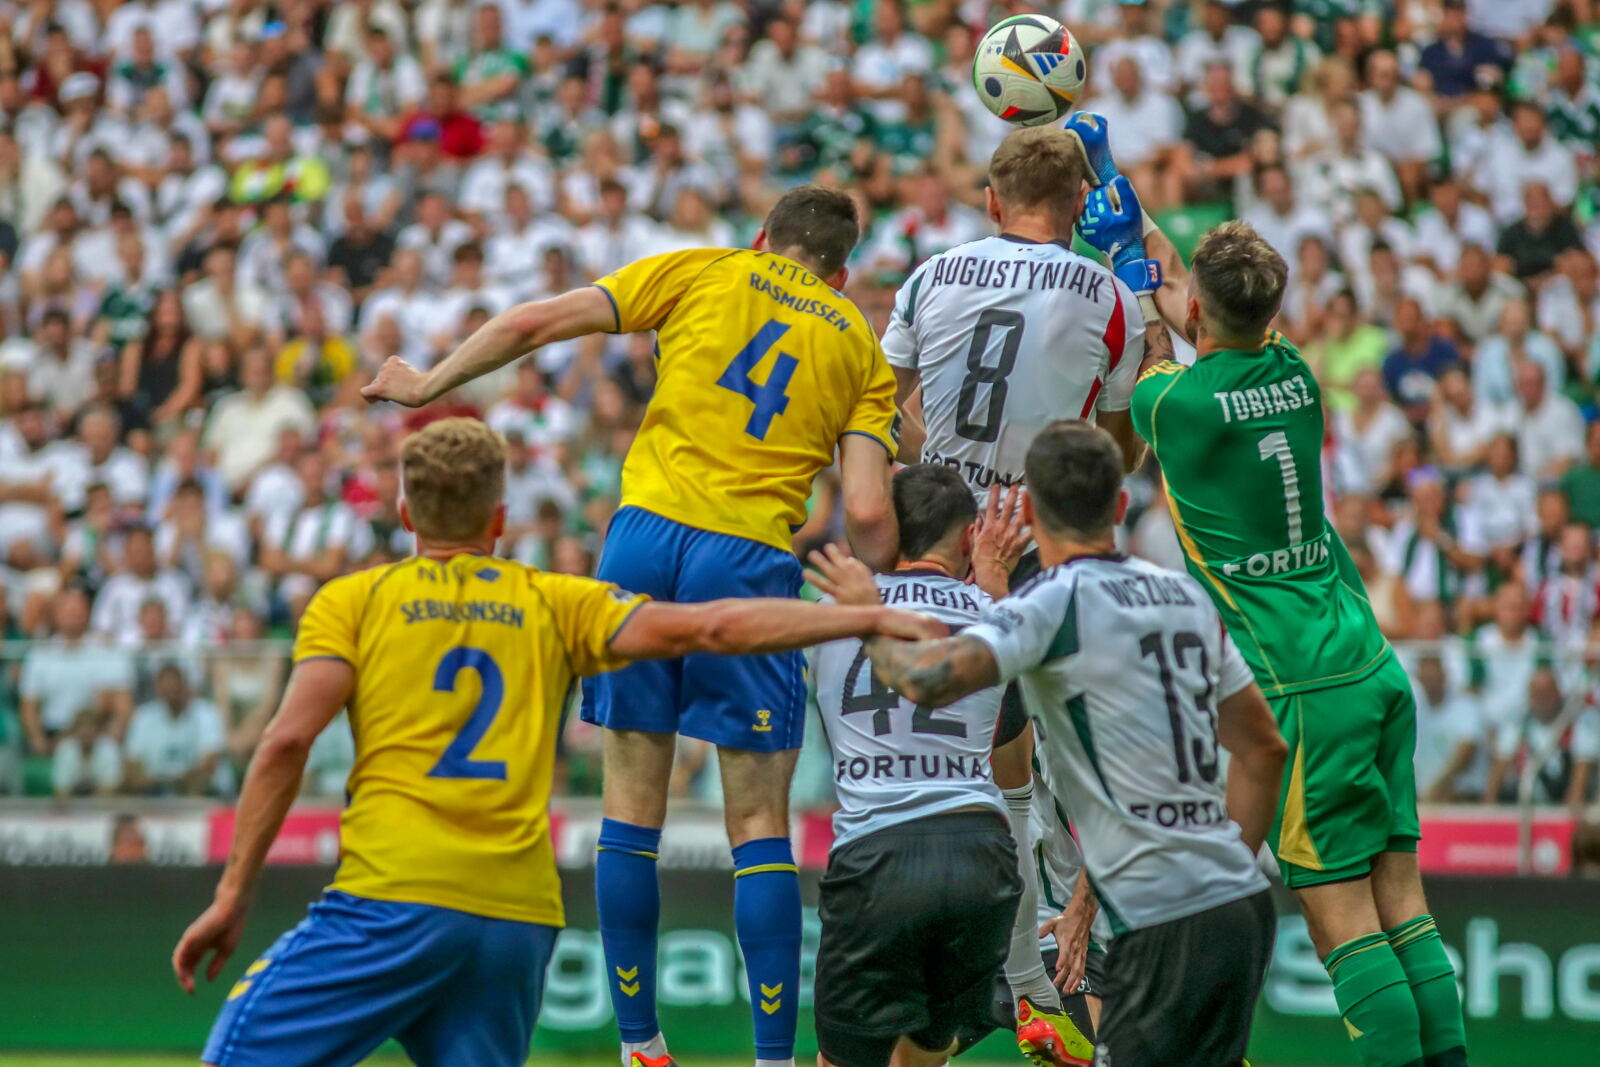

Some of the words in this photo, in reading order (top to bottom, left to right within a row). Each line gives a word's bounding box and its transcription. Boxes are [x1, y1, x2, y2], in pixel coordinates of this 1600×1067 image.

[750, 272, 851, 332] RASMUSSEN
[932, 255, 1105, 303] AUGUSTYNIAK
[715, 318, 799, 441] 4
[955, 308, 1025, 443] 8
[1213, 374, 1314, 423] TOBIASZ
[923, 450, 1024, 489] RTUN
[1258, 431, 1302, 549] 1
[400, 598, 526, 630] SEBUONSEN
[426, 645, 507, 781] 2
[1139, 632, 1219, 784] 13
[837, 754, 988, 783] FORTUNA
[1262, 915, 1600, 1020] Sho
